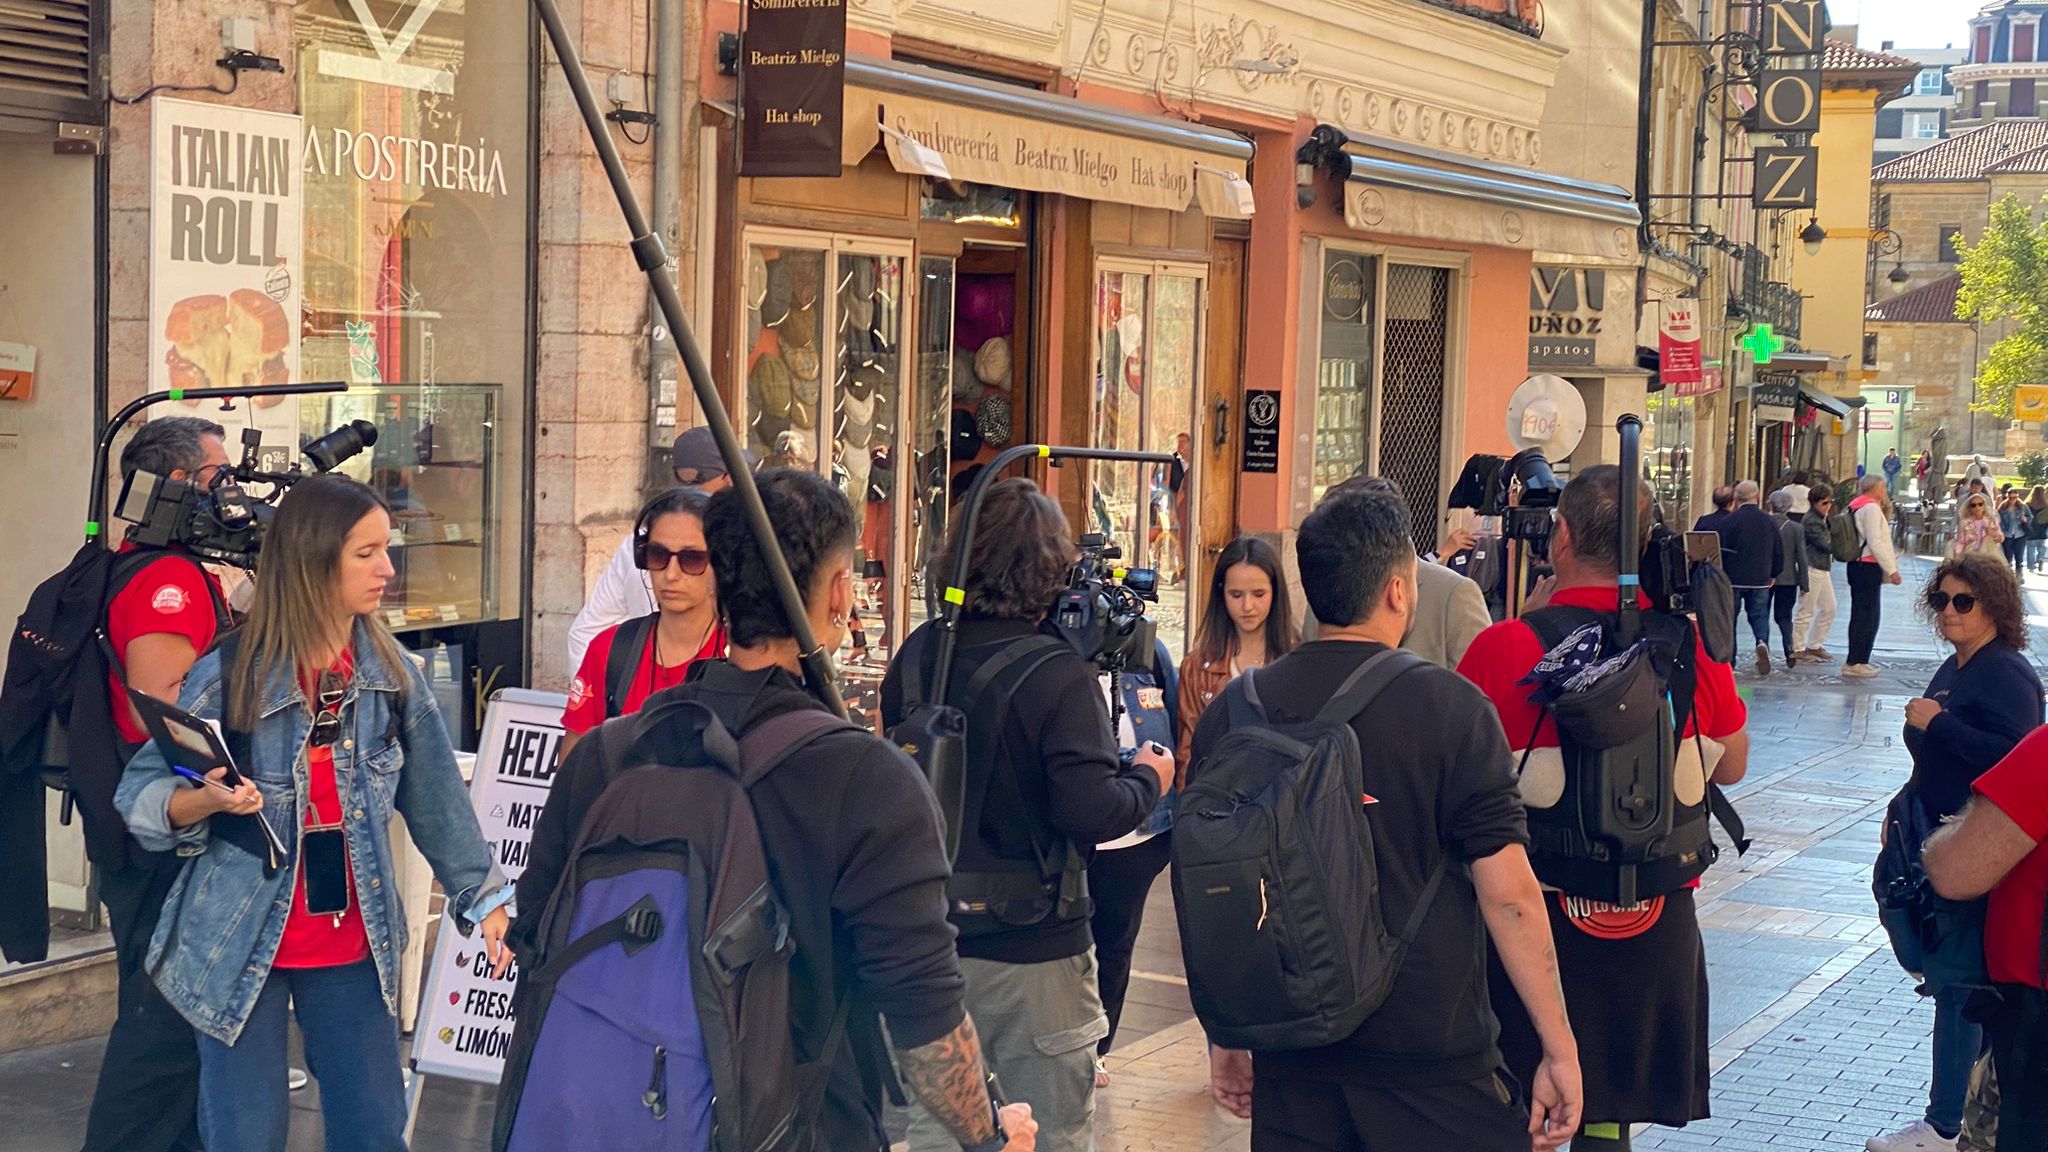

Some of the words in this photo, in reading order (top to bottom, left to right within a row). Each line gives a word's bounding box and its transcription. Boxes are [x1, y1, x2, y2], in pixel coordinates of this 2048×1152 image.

[751, 51, 797, 65] Beatriz
[800, 49, 840, 67] Mielgo
[766, 109, 788, 123] Hat
[792, 109, 821, 126] shop
[172, 124, 289, 197] ITALIAN
[333, 127, 507, 195] POSTRERÍA
[896, 115, 999, 162] Sombrerería
[1015, 138, 1068, 173] Beatriz
[1072, 148, 1117, 187] Mielgo
[1131, 157, 1155, 187] Hat
[1159, 162, 1187, 199] shop
[170, 193, 287, 267] ROLL
[1532, 345, 1590, 357] apatos
[1760, 374, 1796, 387] CENTRO
[464, 989, 516, 1021] FRESA
[455, 1025, 511, 1059] LIMÓN
